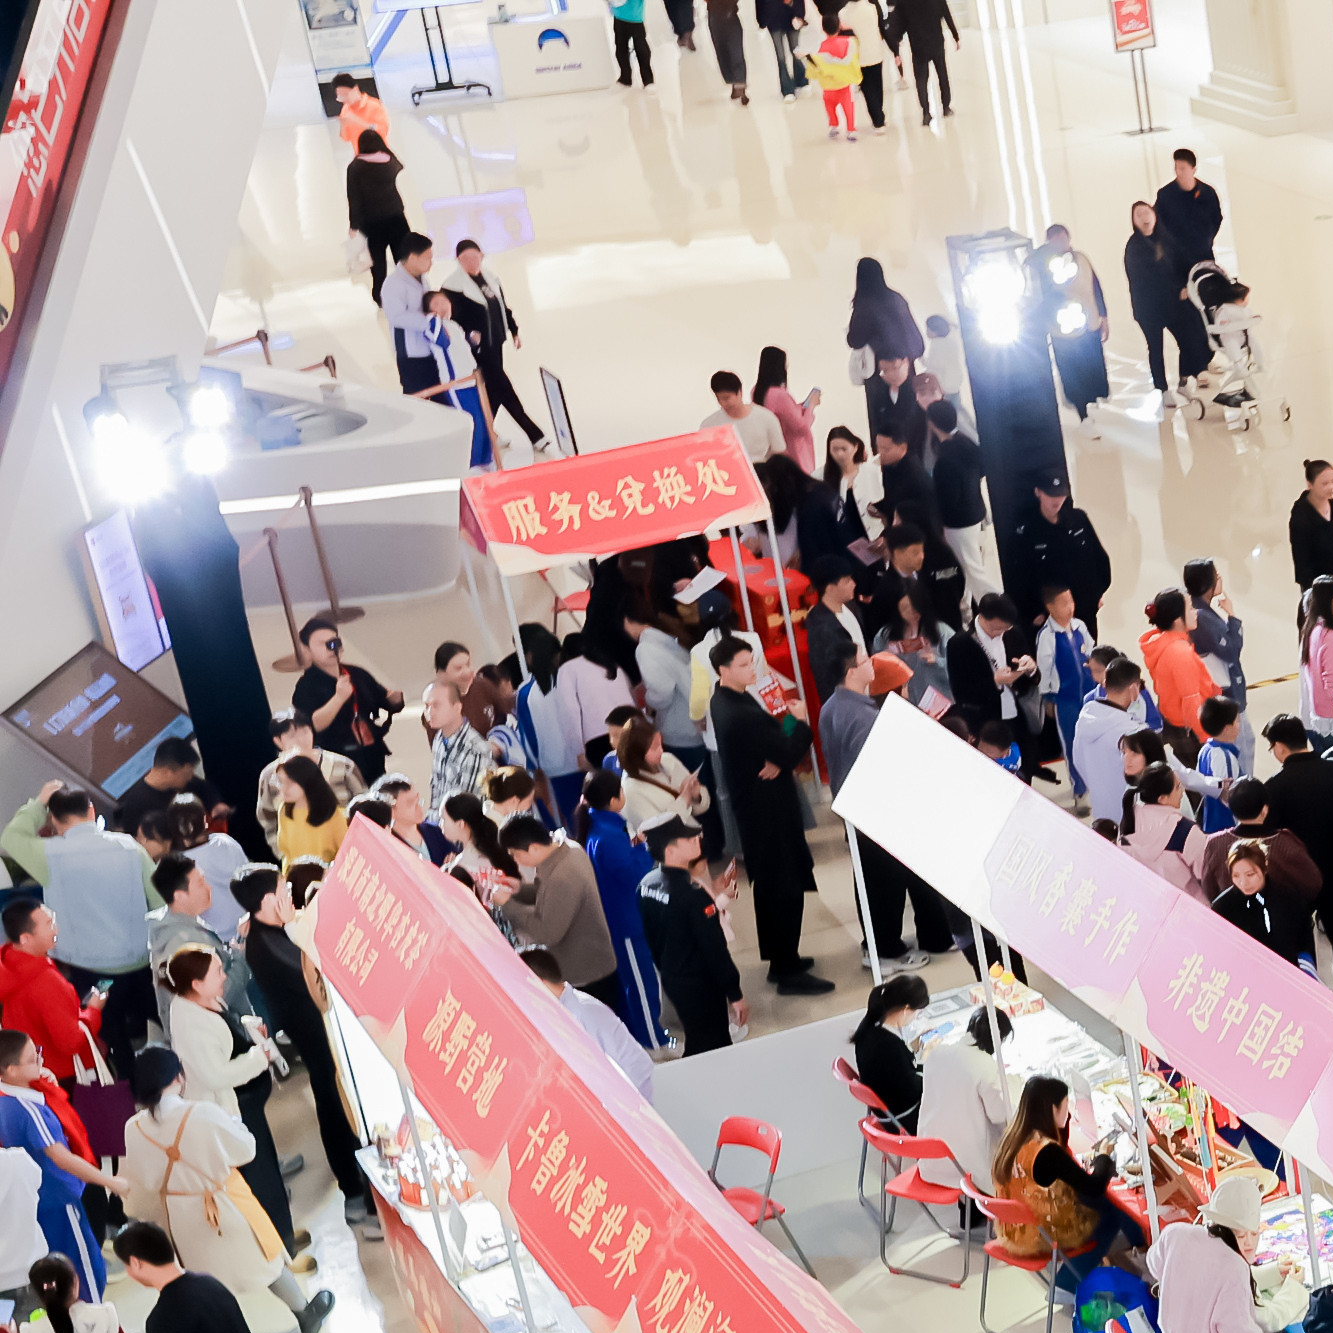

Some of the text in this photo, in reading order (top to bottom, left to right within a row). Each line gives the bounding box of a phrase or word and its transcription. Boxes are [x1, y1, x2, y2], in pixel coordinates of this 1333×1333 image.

[502, 459, 738, 542] 服务&兑换处
[995, 831, 1139, 965] 国风香囊手作
[1164, 952, 1305, 1081] 非遗中国结
[516, 1110, 653, 1287] 卡鲁冰雪世界
